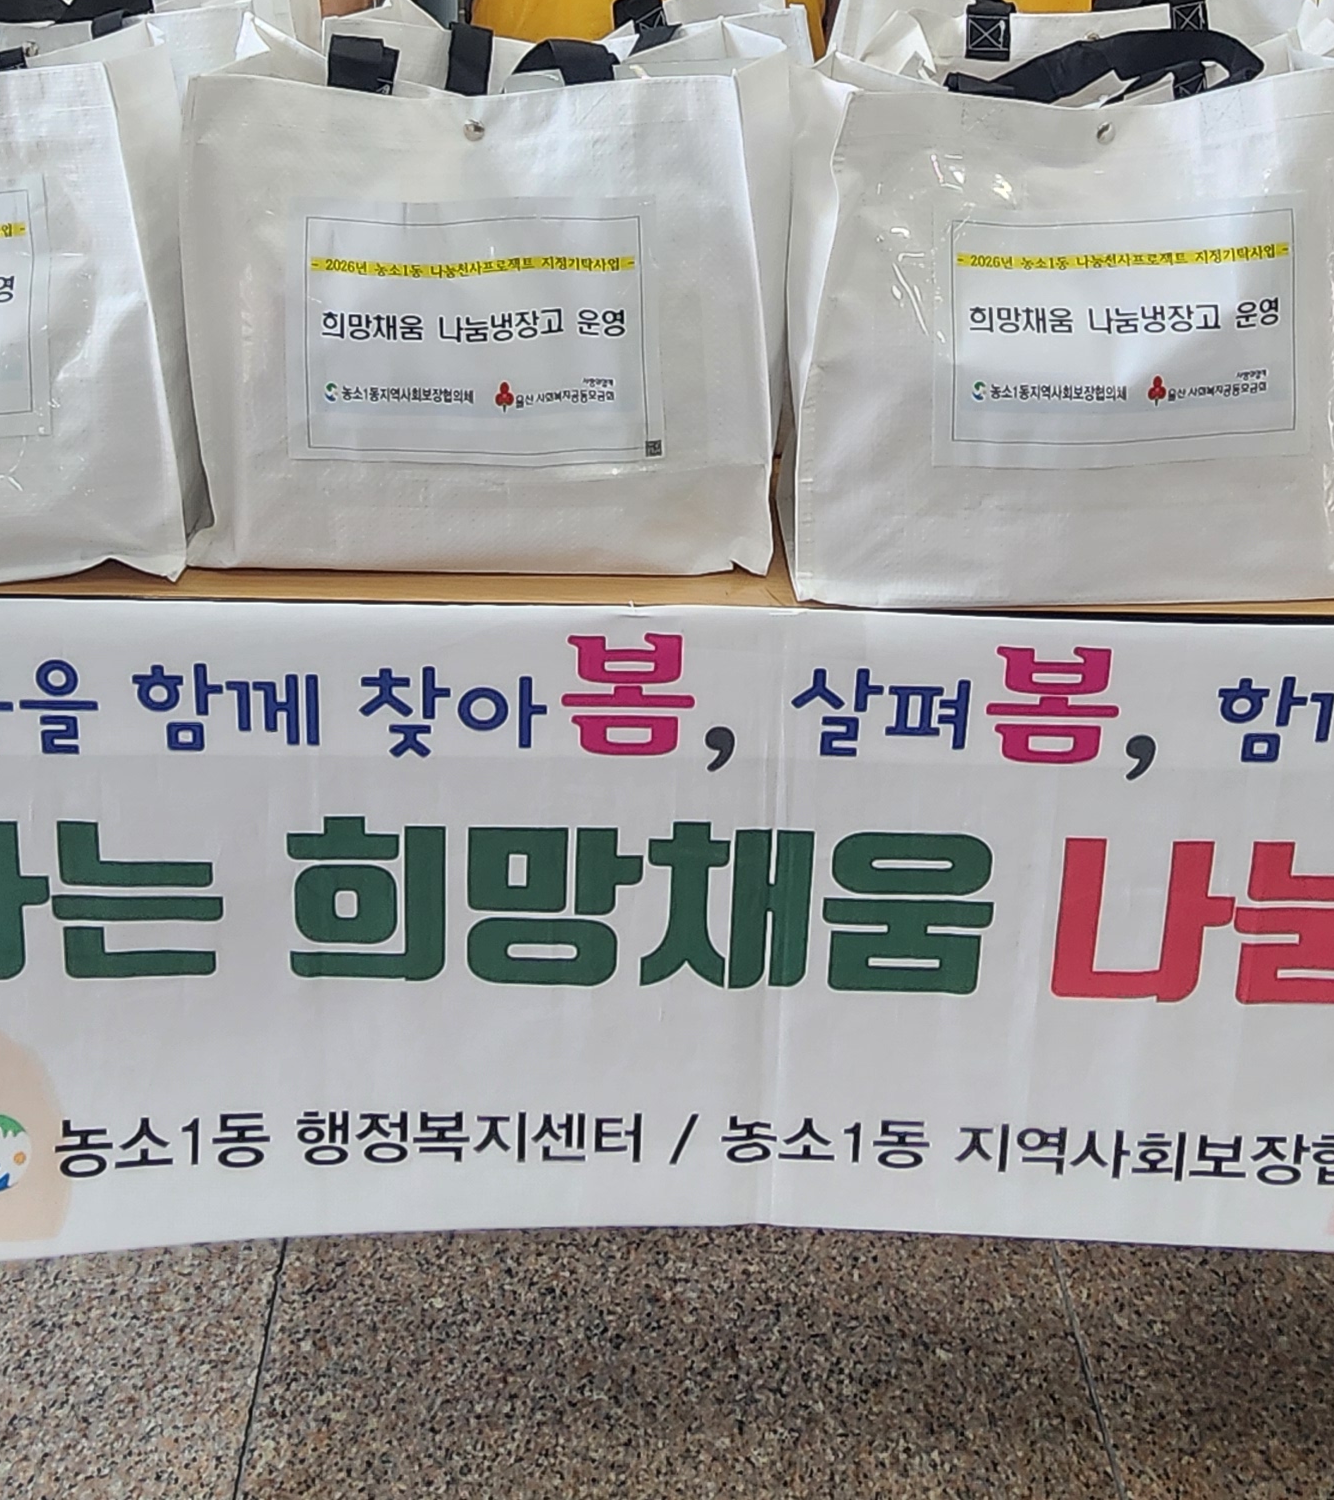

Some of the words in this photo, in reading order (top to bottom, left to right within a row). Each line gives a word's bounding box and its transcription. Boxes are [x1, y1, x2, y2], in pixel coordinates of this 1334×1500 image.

[325, 259, 368, 274] 2026년
[970, 256, 1013, 270] 2026년
[320, 310, 425, 341] 희망채움
[437, 307, 565, 343] 나눔냉장고
[576, 308, 627, 338] 운영
[968, 305, 1074, 334] 희망채움
[1087, 303, 1222, 335] 나눔냉장고
[1234, 296, 1280, 328] 운영
[341, 385, 475, 404] 농소1동지역사회보장협의체
[990, 382, 1128, 401] 농소1동지역사회보장협의체
[131, 662, 322, 753] 함께
[358, 631, 737, 772] 찾아봄,
[790, 644, 1158, 783] 살펴봄,
[286, 814, 995, 995] 희망채움
[53, 1112, 273, 1183] 농소1동
[296, 1109, 645, 1171] 행정복지센터
[720, 1112, 931, 1170] 농소1동
